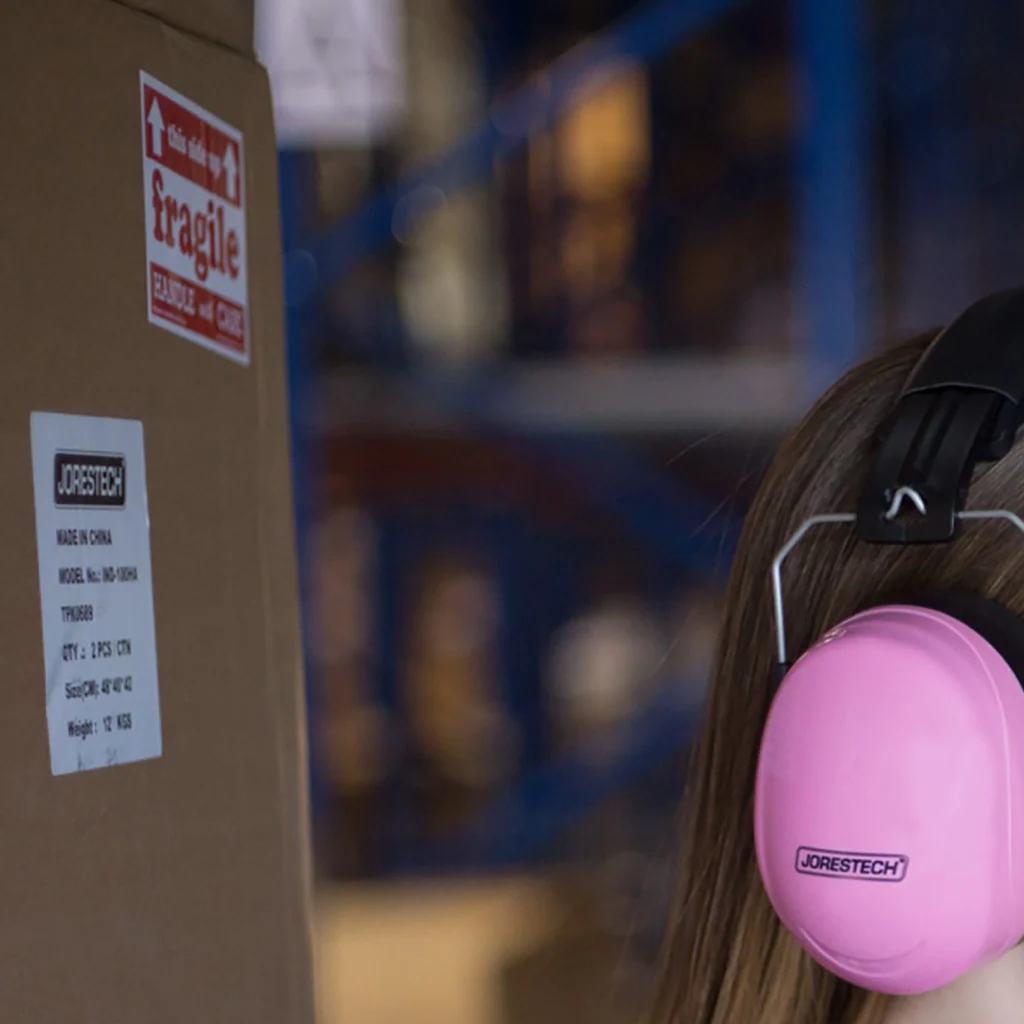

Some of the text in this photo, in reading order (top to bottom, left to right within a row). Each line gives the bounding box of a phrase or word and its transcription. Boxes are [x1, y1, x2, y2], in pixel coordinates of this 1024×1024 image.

[151, 167, 240, 283] fragile
[58, 463, 123, 497] JORESTECH
[56, 528, 113, 546] MADE IN CHINA
[58, 566, 85, 585] MODEL
[800, 853, 900, 876] JORESTECH
